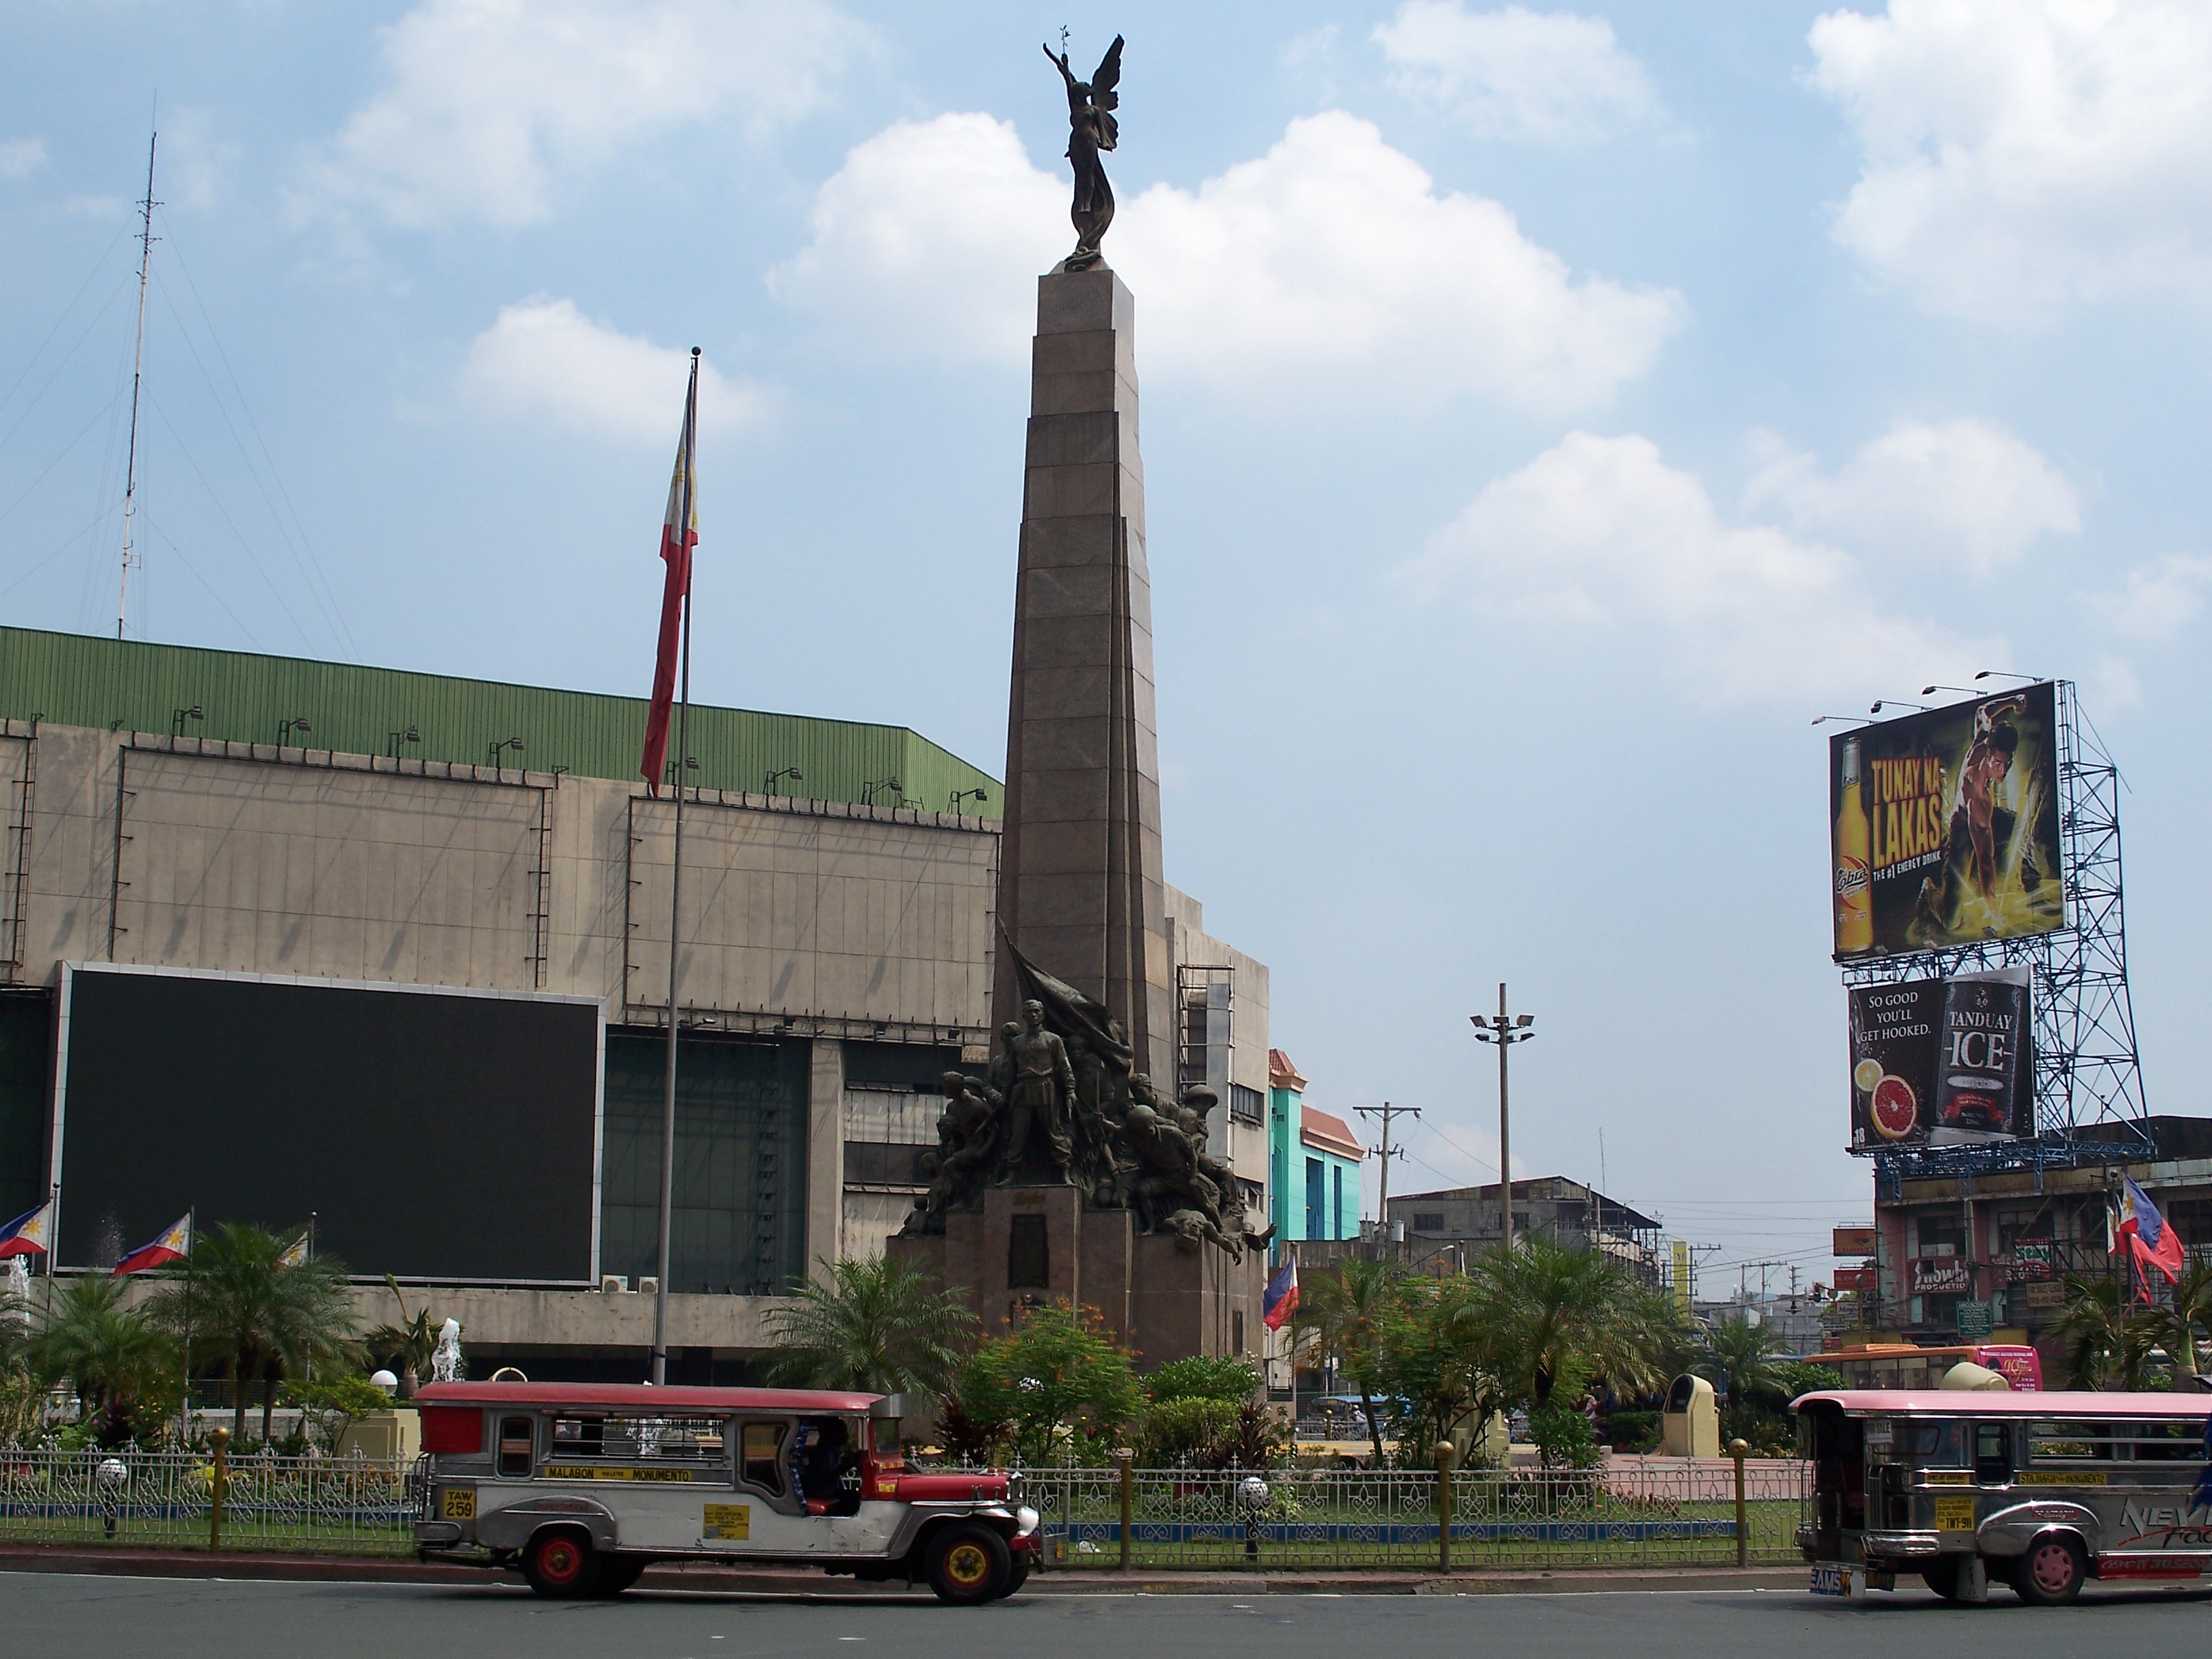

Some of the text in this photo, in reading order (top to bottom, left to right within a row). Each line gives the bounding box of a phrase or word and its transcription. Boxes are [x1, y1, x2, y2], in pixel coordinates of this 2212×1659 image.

[1871, 756, 1941, 804] TUNAY NA
[1873, 794, 1942, 869] LAKAS
[1873, 851, 1941, 881] THE #1 ENERGY DRINK
[1836, 867, 1868, 893] Cobra
[1868, 991, 1918, 1008] SO GOOD
[1877, 1008, 1912, 1024] YOU'LL
[1950, 1011, 2013, 1030] TANDUAY
[1860, 1024, 1931, 1042] GET HOOKED.
[1950, 1031, 2006, 1071] ICE
[1914, 1282, 1965, 1291] PRODUCTIO
[549, 1467, 594, 1479] MALABON
[632, 1470, 689, 1481] MONUMENTO
[447, 1491, 473, 1500] TAW
[447, 1502, 472, 1517] 259
